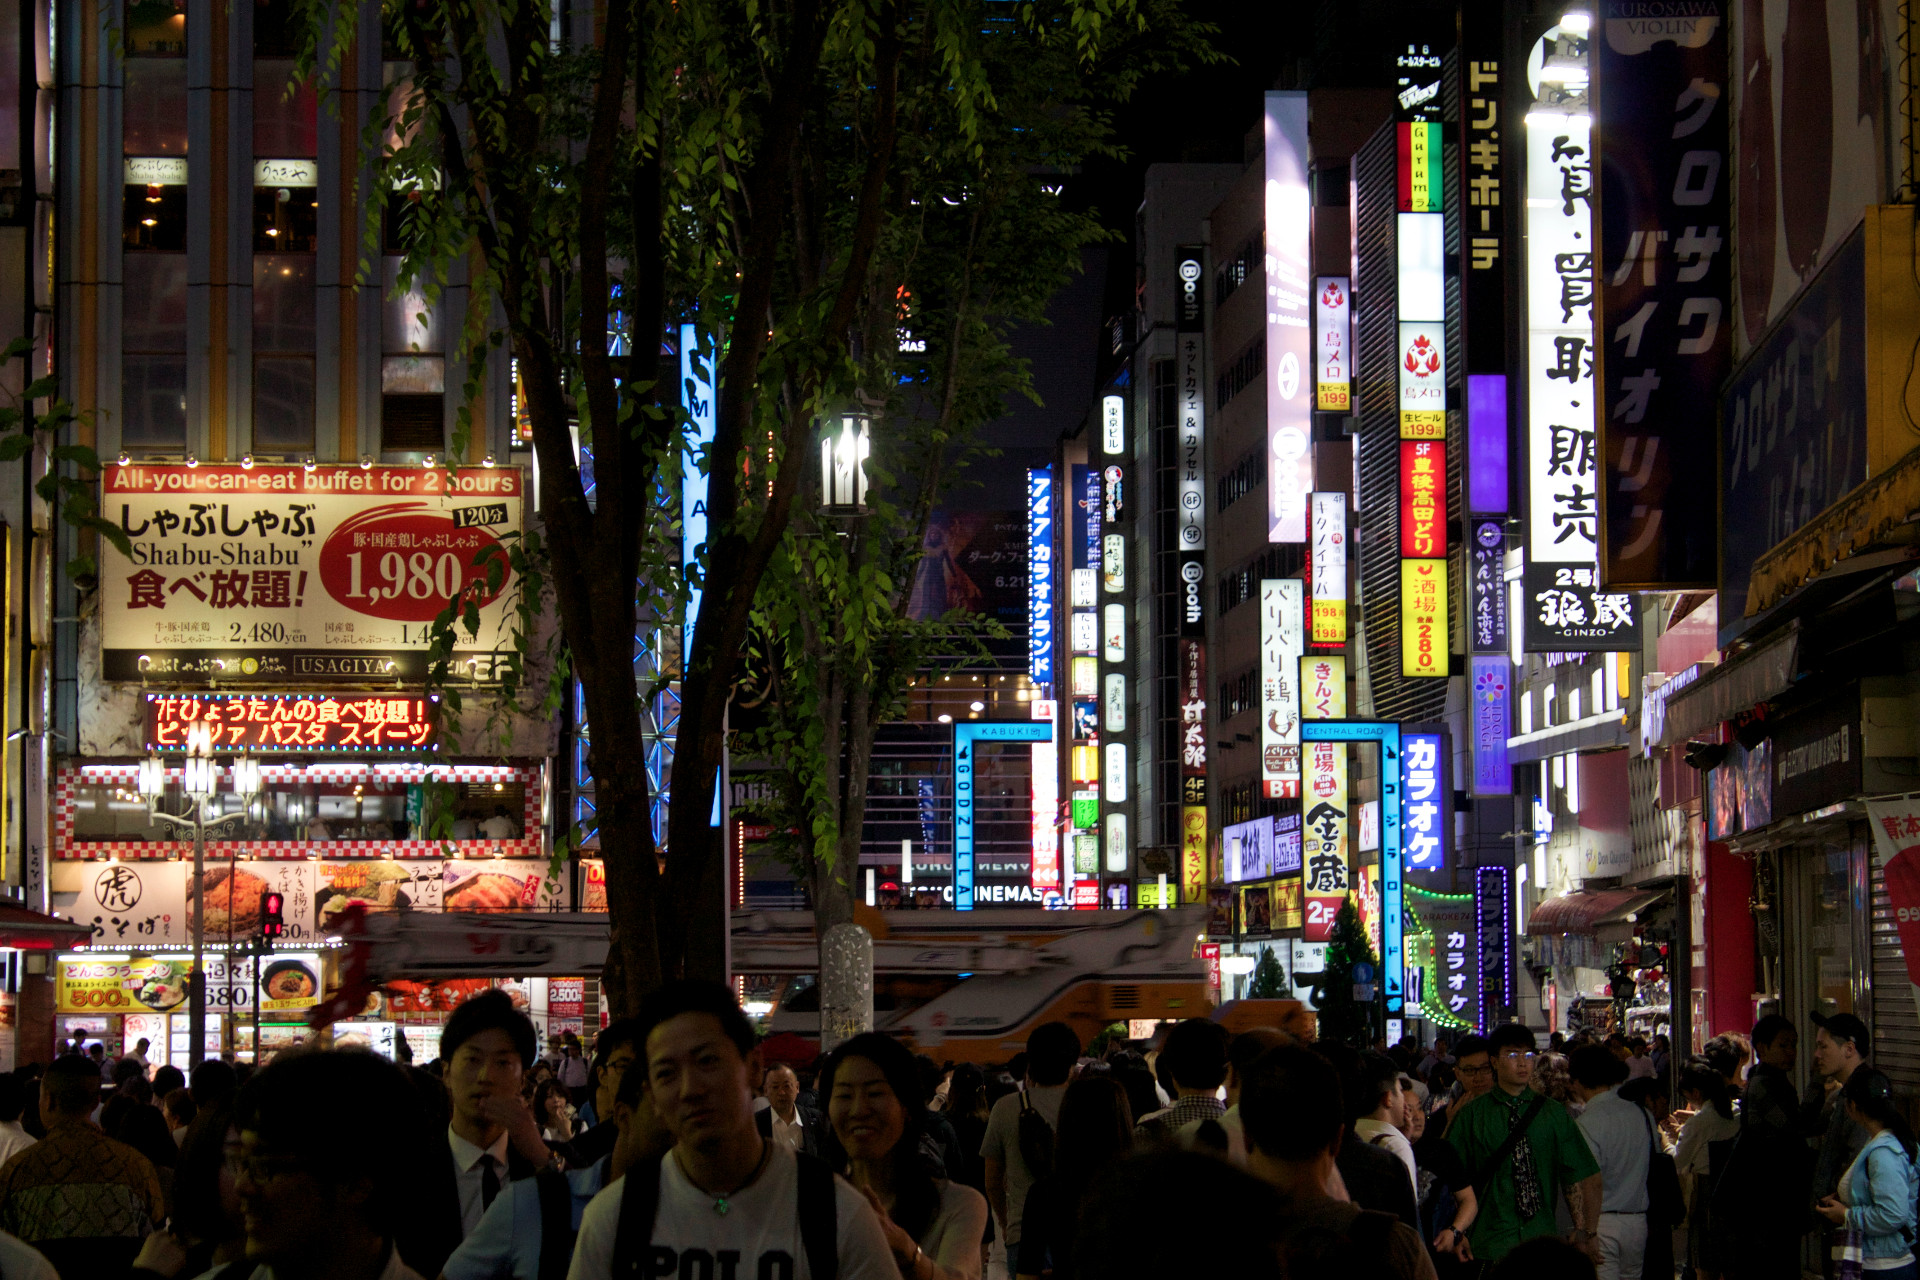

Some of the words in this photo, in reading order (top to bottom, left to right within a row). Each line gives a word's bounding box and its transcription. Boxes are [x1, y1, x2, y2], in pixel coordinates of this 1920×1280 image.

[1627, 19, 1697, 35] VIOLIN
[1671, 77, 1723, 356] クロサワ
[1325, 331, 1341, 379] 鳥メロ
[1405, 386, 1442, 399] 鳥メロ
[1612, 230, 1669, 560] バイオリン
[1404, 413, 1442, 423] 生ビール
[1415, 443, 1431, 455] 5F
[113, 468, 297, 491] All-you-can-eat
[303, 470, 373, 491] buffet
[381, 471, 416, 492] for
[423, 472, 439, 491] 2
[121, 503, 316, 537] しゃぶしゃぶ
[457, 506, 504, 528] 120分
[1411, 457, 1436, 556] 豊後高田どり
[353, 532, 480, 549] 豚・国産鶏しゃぶしゃぶ
[126, 569, 308, 609] 食べ放題!
[345, 551, 462, 606] 1,980
[1181, 560, 1204, 624] Booth
[1555, 568, 1596, 587] 2号
[1032, 543, 1052, 677] カラオケランド
[1413, 578, 1437, 613] 酒場
[1476, 549, 1494, 646] かんかん商店
[1535, 588, 1634, 629] 銀蔵
[229, 621, 285, 645] 2,480
[284, 632, 307, 645] yen
[1418, 624, 1433, 667] 280
[301, 658, 386, 673] USAGIYA
[1315, 662, 1332, 719] きんく
[154, 698, 424, 723] 7Fひょうたんの食べ放題!
[1481, 705, 1492, 751] STAGE
[1491, 706, 1502, 743] IDOL
[258, 721, 327, 744] パスタ
[339, 721, 430, 745] スイーツ
[1181, 698, 1206, 768] 甘太郎
[1306, 727, 1352, 735] CENTRAL
[1356, 727, 1384, 735] ROAD
[1185, 777, 1205, 790] 4F
[1269, 781, 1296, 797] B1
[1407, 738, 1439, 864] カラオケ
[958, 764, 971, 895] GODZILLA
[1306, 801, 1347, 892] 金の蔵
[277, 867, 291, 893] そば
[1184, 832, 1202, 903] やきとり
[99, 866, 136, 910] 虎
[294, 866, 308, 919] かき揚げ
[425, 865, 438, 912] とんこ
[974, 885, 1044, 902] INEMAS
[68, 915, 160, 938] らそば
[1307, 900, 1335, 925] 2F
[1481, 874, 1504, 972] カラオケ
[280, 923, 310, 940] 50円
[65, 965, 172, 978] とんこつラーメン
[1446, 931, 1469, 1013] カラオケ
[1483, 976, 1504, 992] B1
[205, 986, 253, 1006] 680
